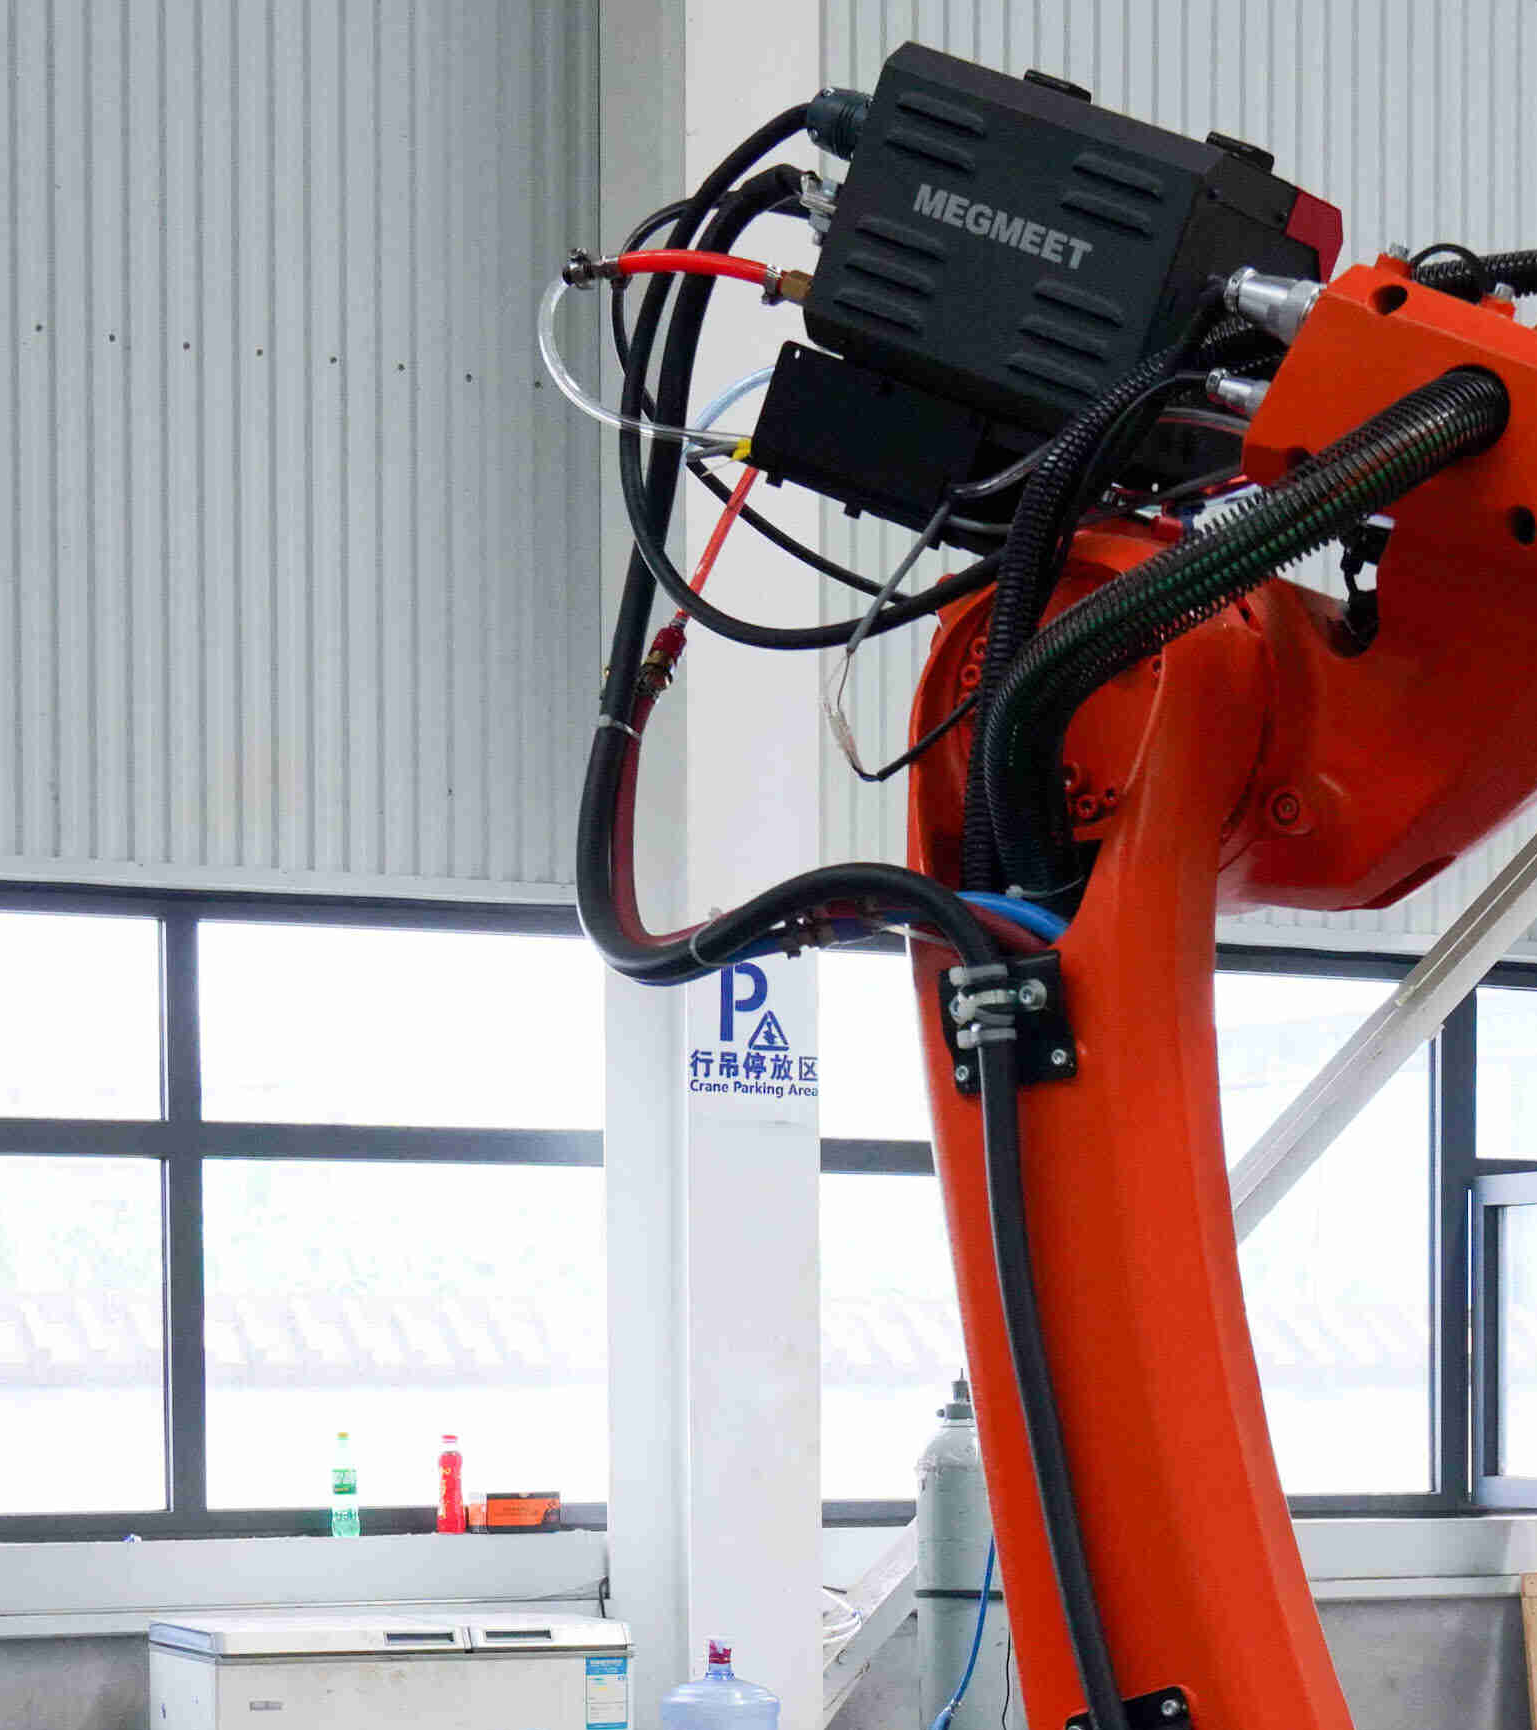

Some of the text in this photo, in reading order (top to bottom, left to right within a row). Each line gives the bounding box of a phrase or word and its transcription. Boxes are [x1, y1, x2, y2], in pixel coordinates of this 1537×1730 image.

[911, 183, 1095, 271] MEGMEET
[720, 962, 768, 1042] P
[689, 1079, 818, 1098] Crane Parking Area
[690, 1049, 818, 1081] 行吊停放区
